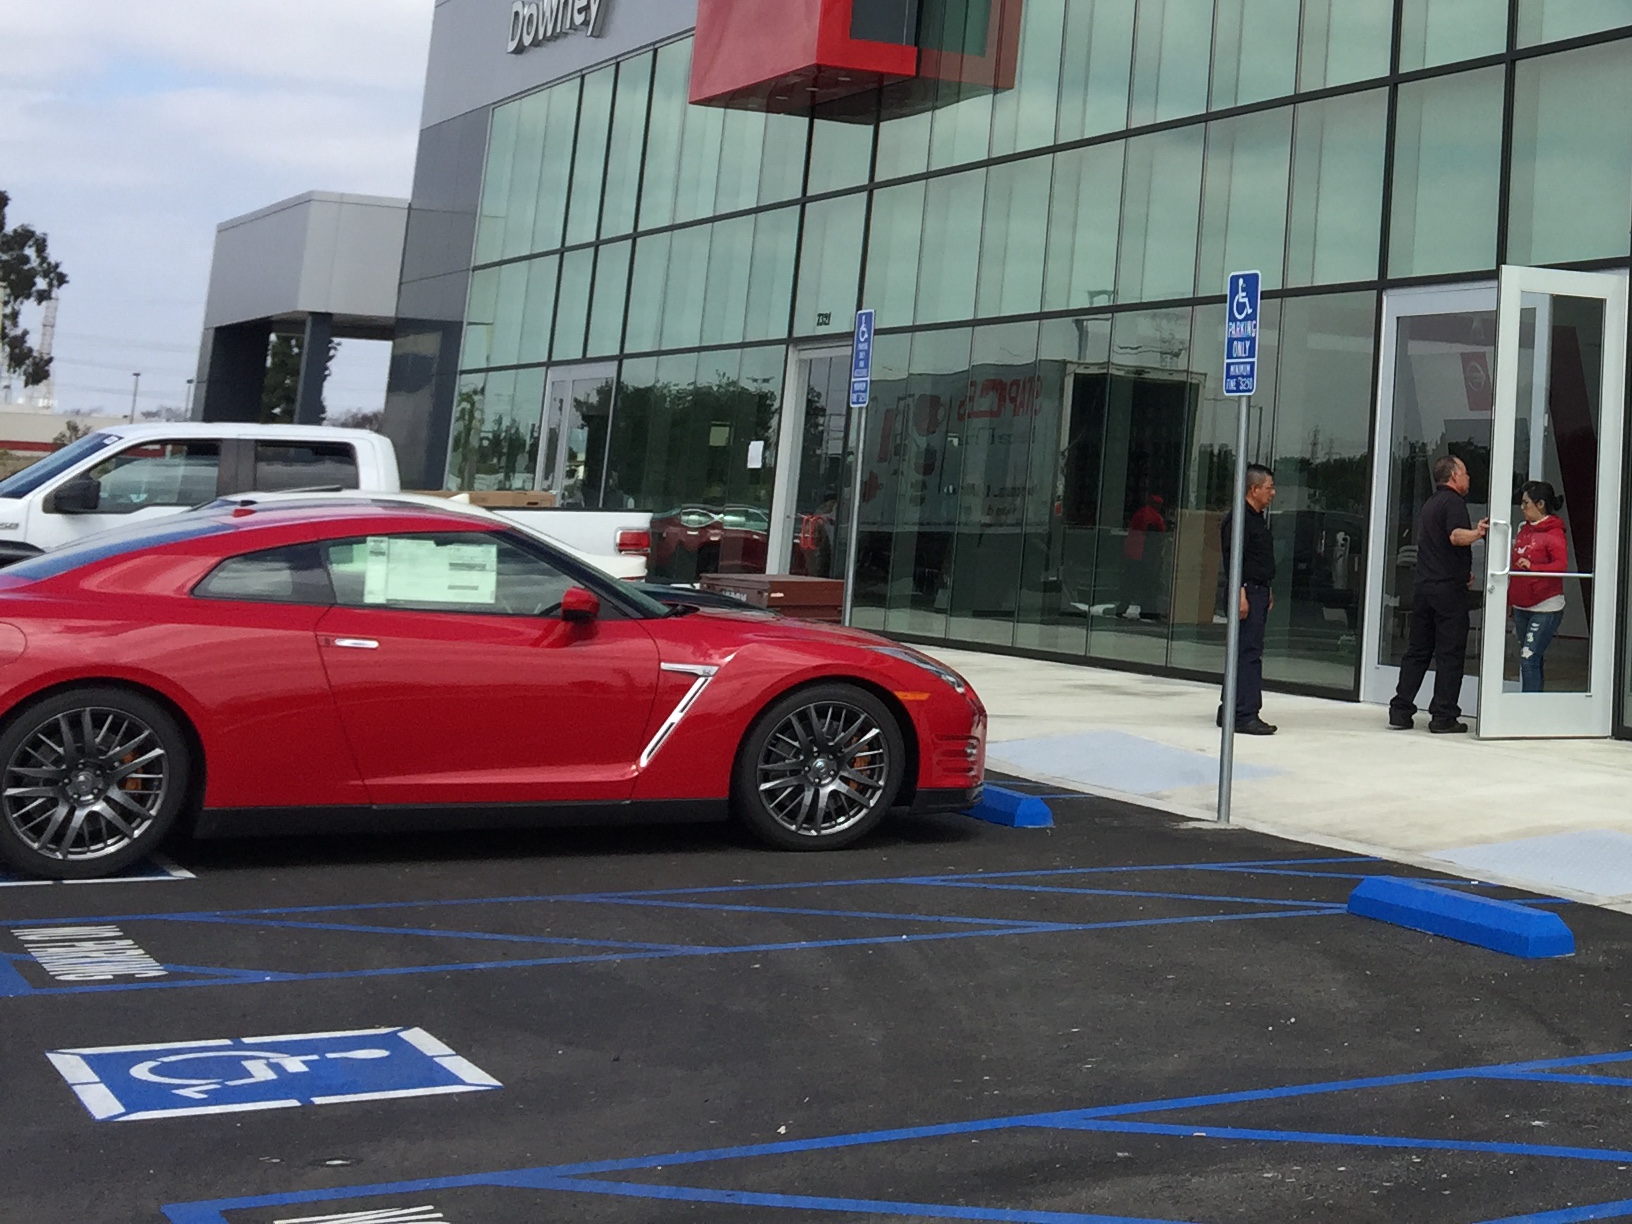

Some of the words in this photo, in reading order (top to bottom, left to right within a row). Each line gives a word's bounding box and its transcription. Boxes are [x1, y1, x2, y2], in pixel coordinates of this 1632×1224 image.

[1228, 320, 1257, 338] PARKING
[1232, 340, 1251, 357] ONLY
[10, 925, 124, 941] NO
[23, 939, 169, 981] PARKING
